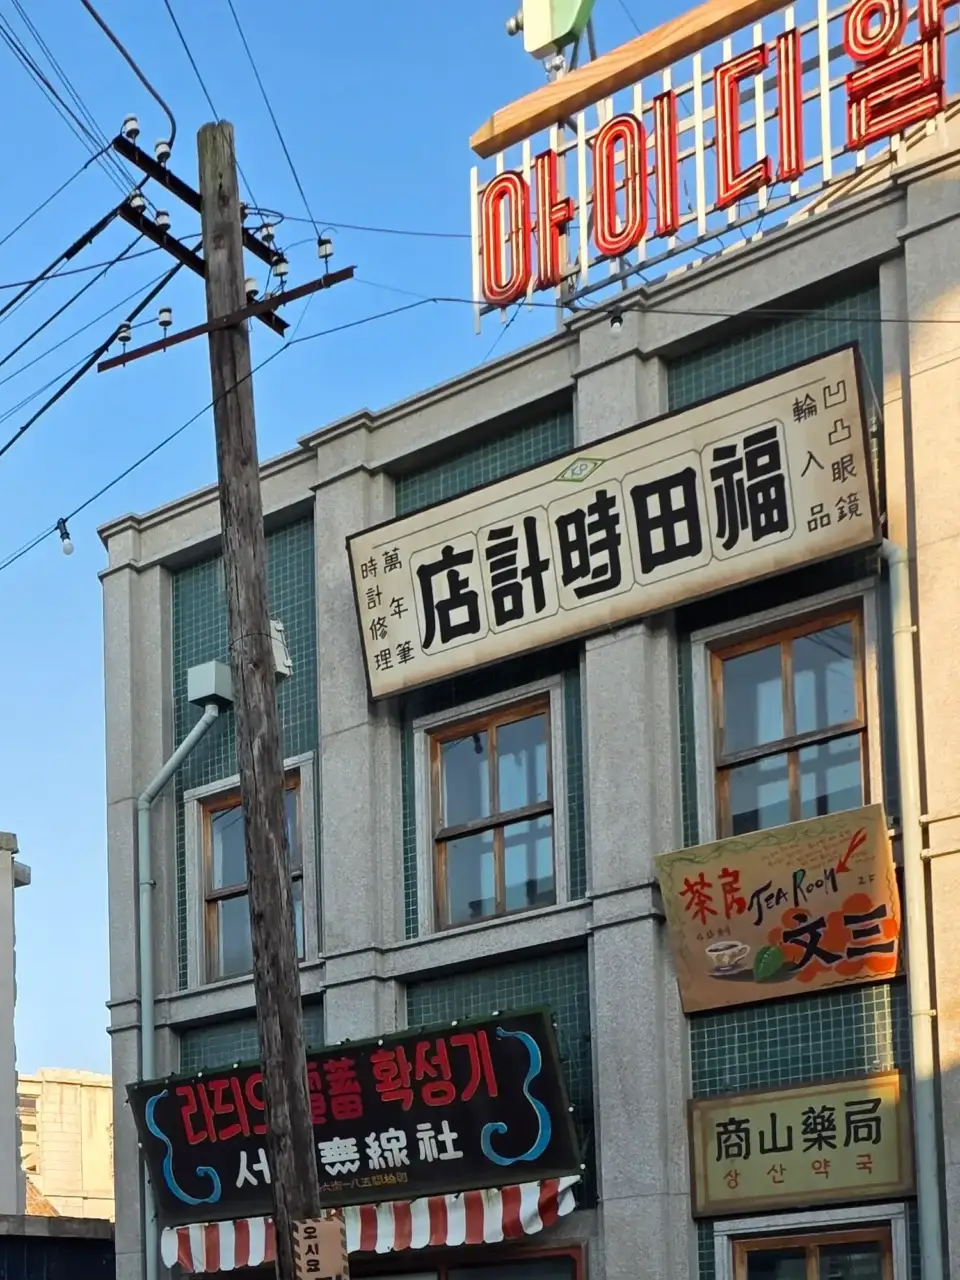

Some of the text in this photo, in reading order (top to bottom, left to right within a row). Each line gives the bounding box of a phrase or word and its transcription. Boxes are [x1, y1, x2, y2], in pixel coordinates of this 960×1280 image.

[369, 1030, 498, 1111] 확성기
[715, 1097, 883, 1163] 商山藥局
